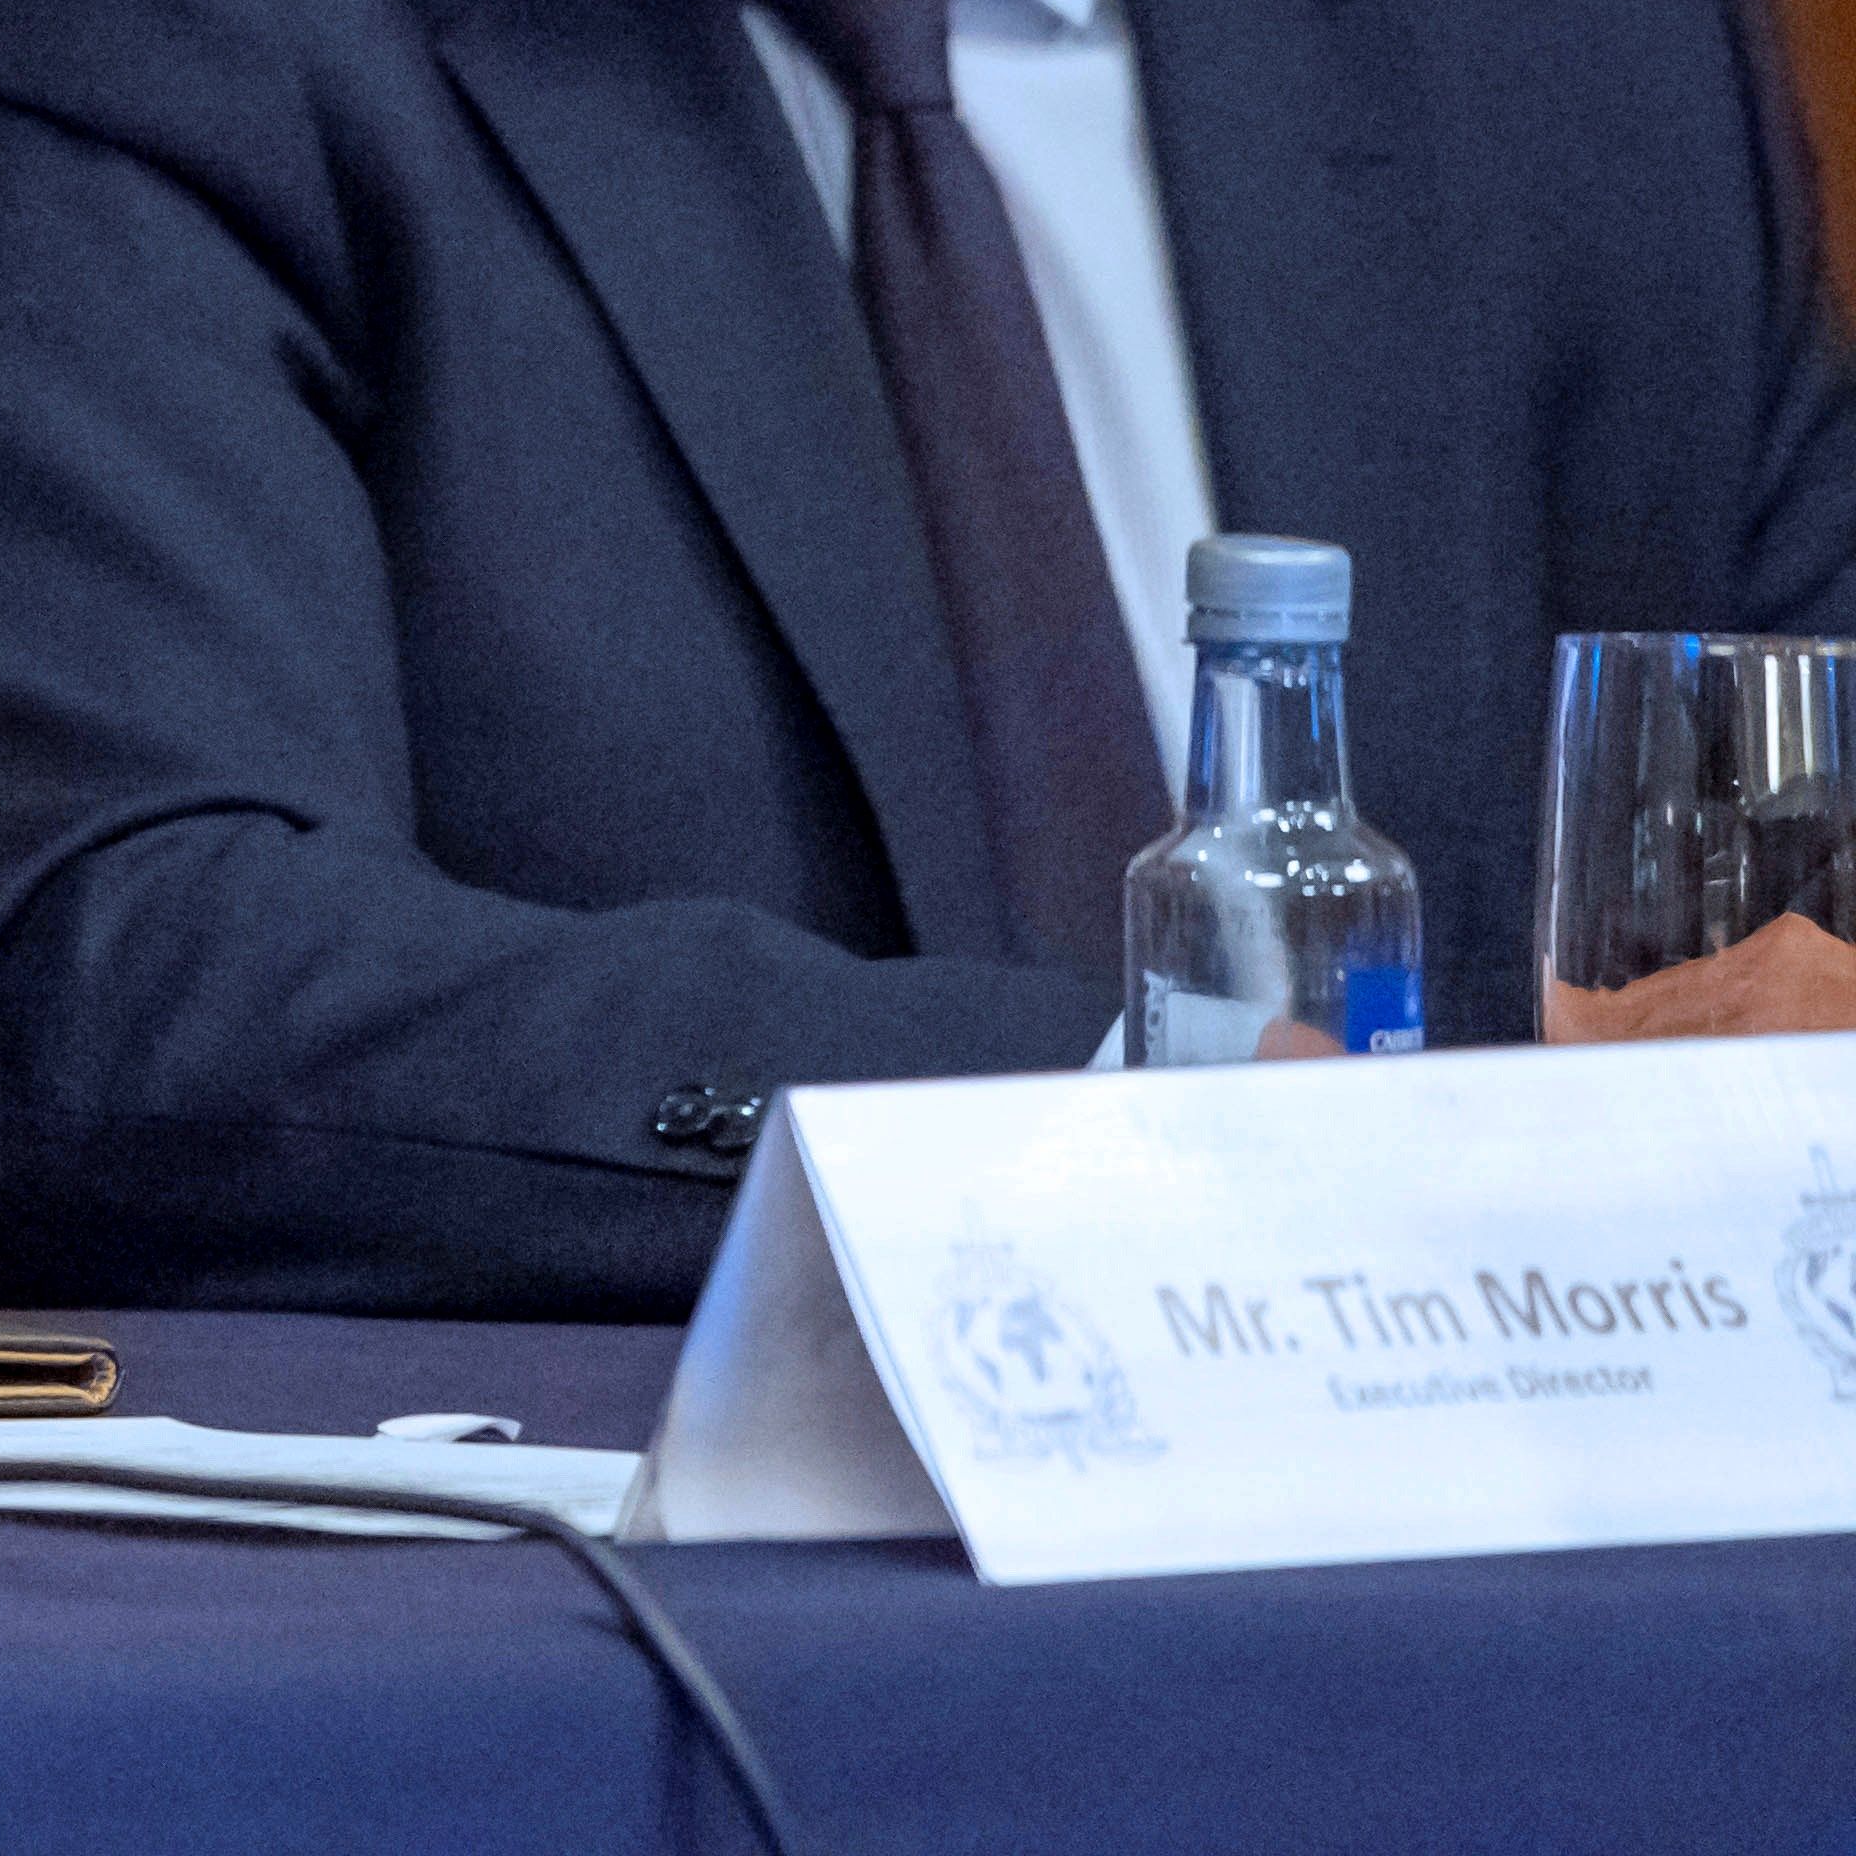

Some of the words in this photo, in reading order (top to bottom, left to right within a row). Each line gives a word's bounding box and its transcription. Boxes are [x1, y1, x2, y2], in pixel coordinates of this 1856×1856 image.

[1154, 1280, 1299, 1356] Mr.
[1302, 1270, 1469, 1348] Tim
[1474, 1258, 1749, 1339] Morris
[1327, 1371, 1503, 1412] Executive
[1505, 1363, 1655, 1401] Director
